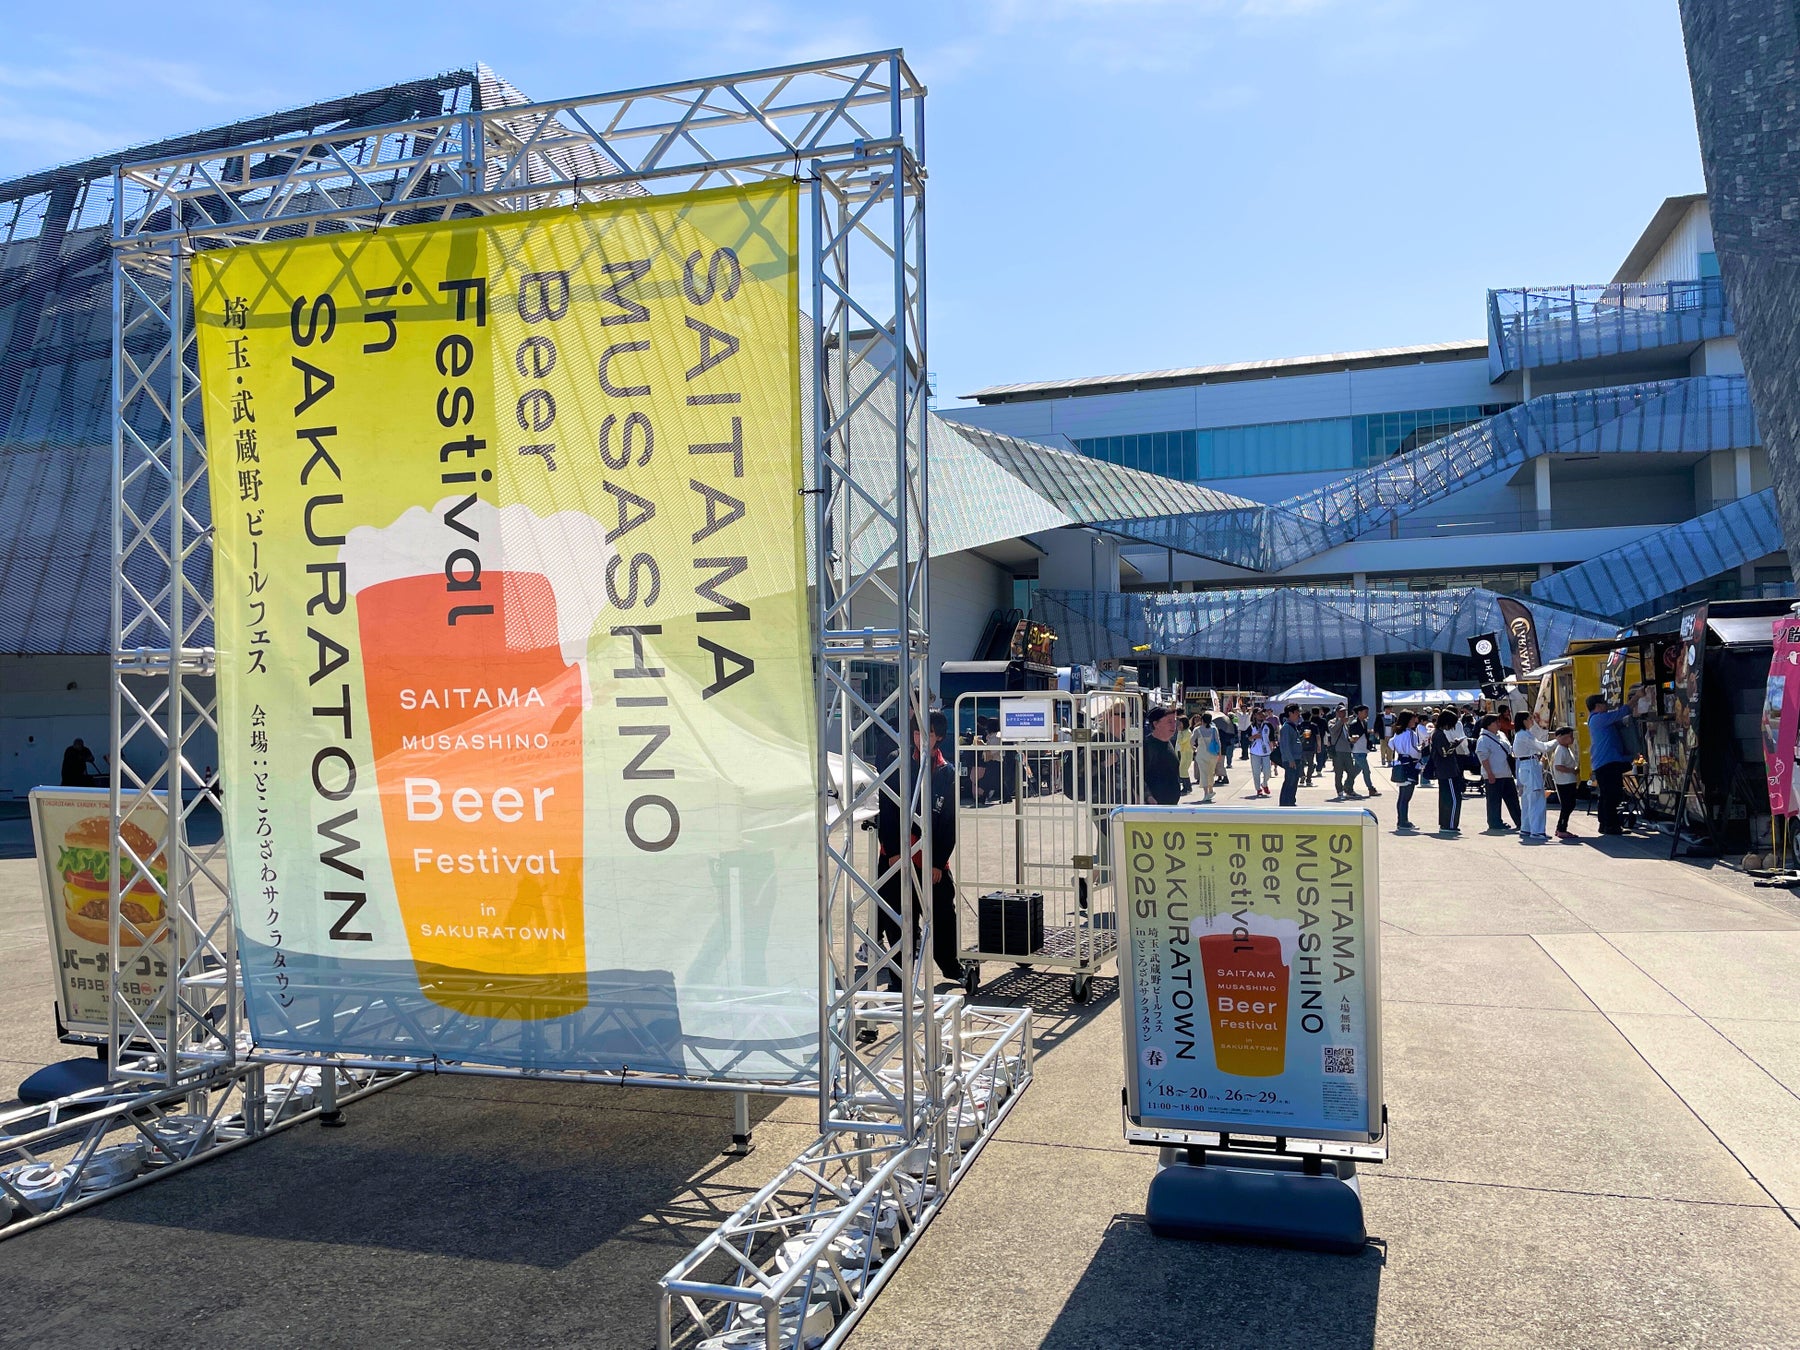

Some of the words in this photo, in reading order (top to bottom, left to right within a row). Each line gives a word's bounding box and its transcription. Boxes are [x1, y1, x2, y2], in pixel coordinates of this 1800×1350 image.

[363, 281, 413, 355] in
[515, 270, 570, 473] Beer
[435, 276, 495, 627] Festival
[682, 246, 756, 701] SAITAMA
[222, 297, 271, 674] 埼玉・武蔵野ビールフェス
[598, 257, 681, 853] MUSASHINO
[290, 292, 374, 943] SAKURATOWN
[400, 686, 545, 710] SAITAMA
[402, 732, 549, 752] MUSASHINO
[404, 777, 555, 823] Beer
[413, 846, 560, 875] Festival
[1195, 832, 1219, 857] in
[1131, 830, 1157, 919] 2025
[1261, 833, 1284, 905] Beer
[480, 902, 496, 917] in
[1228, 833, 1255, 954] Festival
[1328, 833, 1356, 985] SAITAMA
[420, 923, 566, 941] SAKURATOWN
[1163, 830, 1196, 1061] SAKURATOWN
[1295, 834, 1325, 1034] MUSASHINO
[1147, 927, 1164, 1033] 埼玉・武蔵野ビールフェス
[1217, 968, 1276, 979] SAITAMA
[1217, 983, 1277, 992] MUSASHINO
[1218, 997, 1278, 1014] Beer
[1220, 1019, 1278, 1031] Festival
[1340, 994, 1351, 1034] 入場無料
[1147, 1050, 1163, 1066] 春
[1220, 1043, 1279, 1052] SAKURATOWN
[1147, 1101, 1205, 1113] 11:00~18:00
